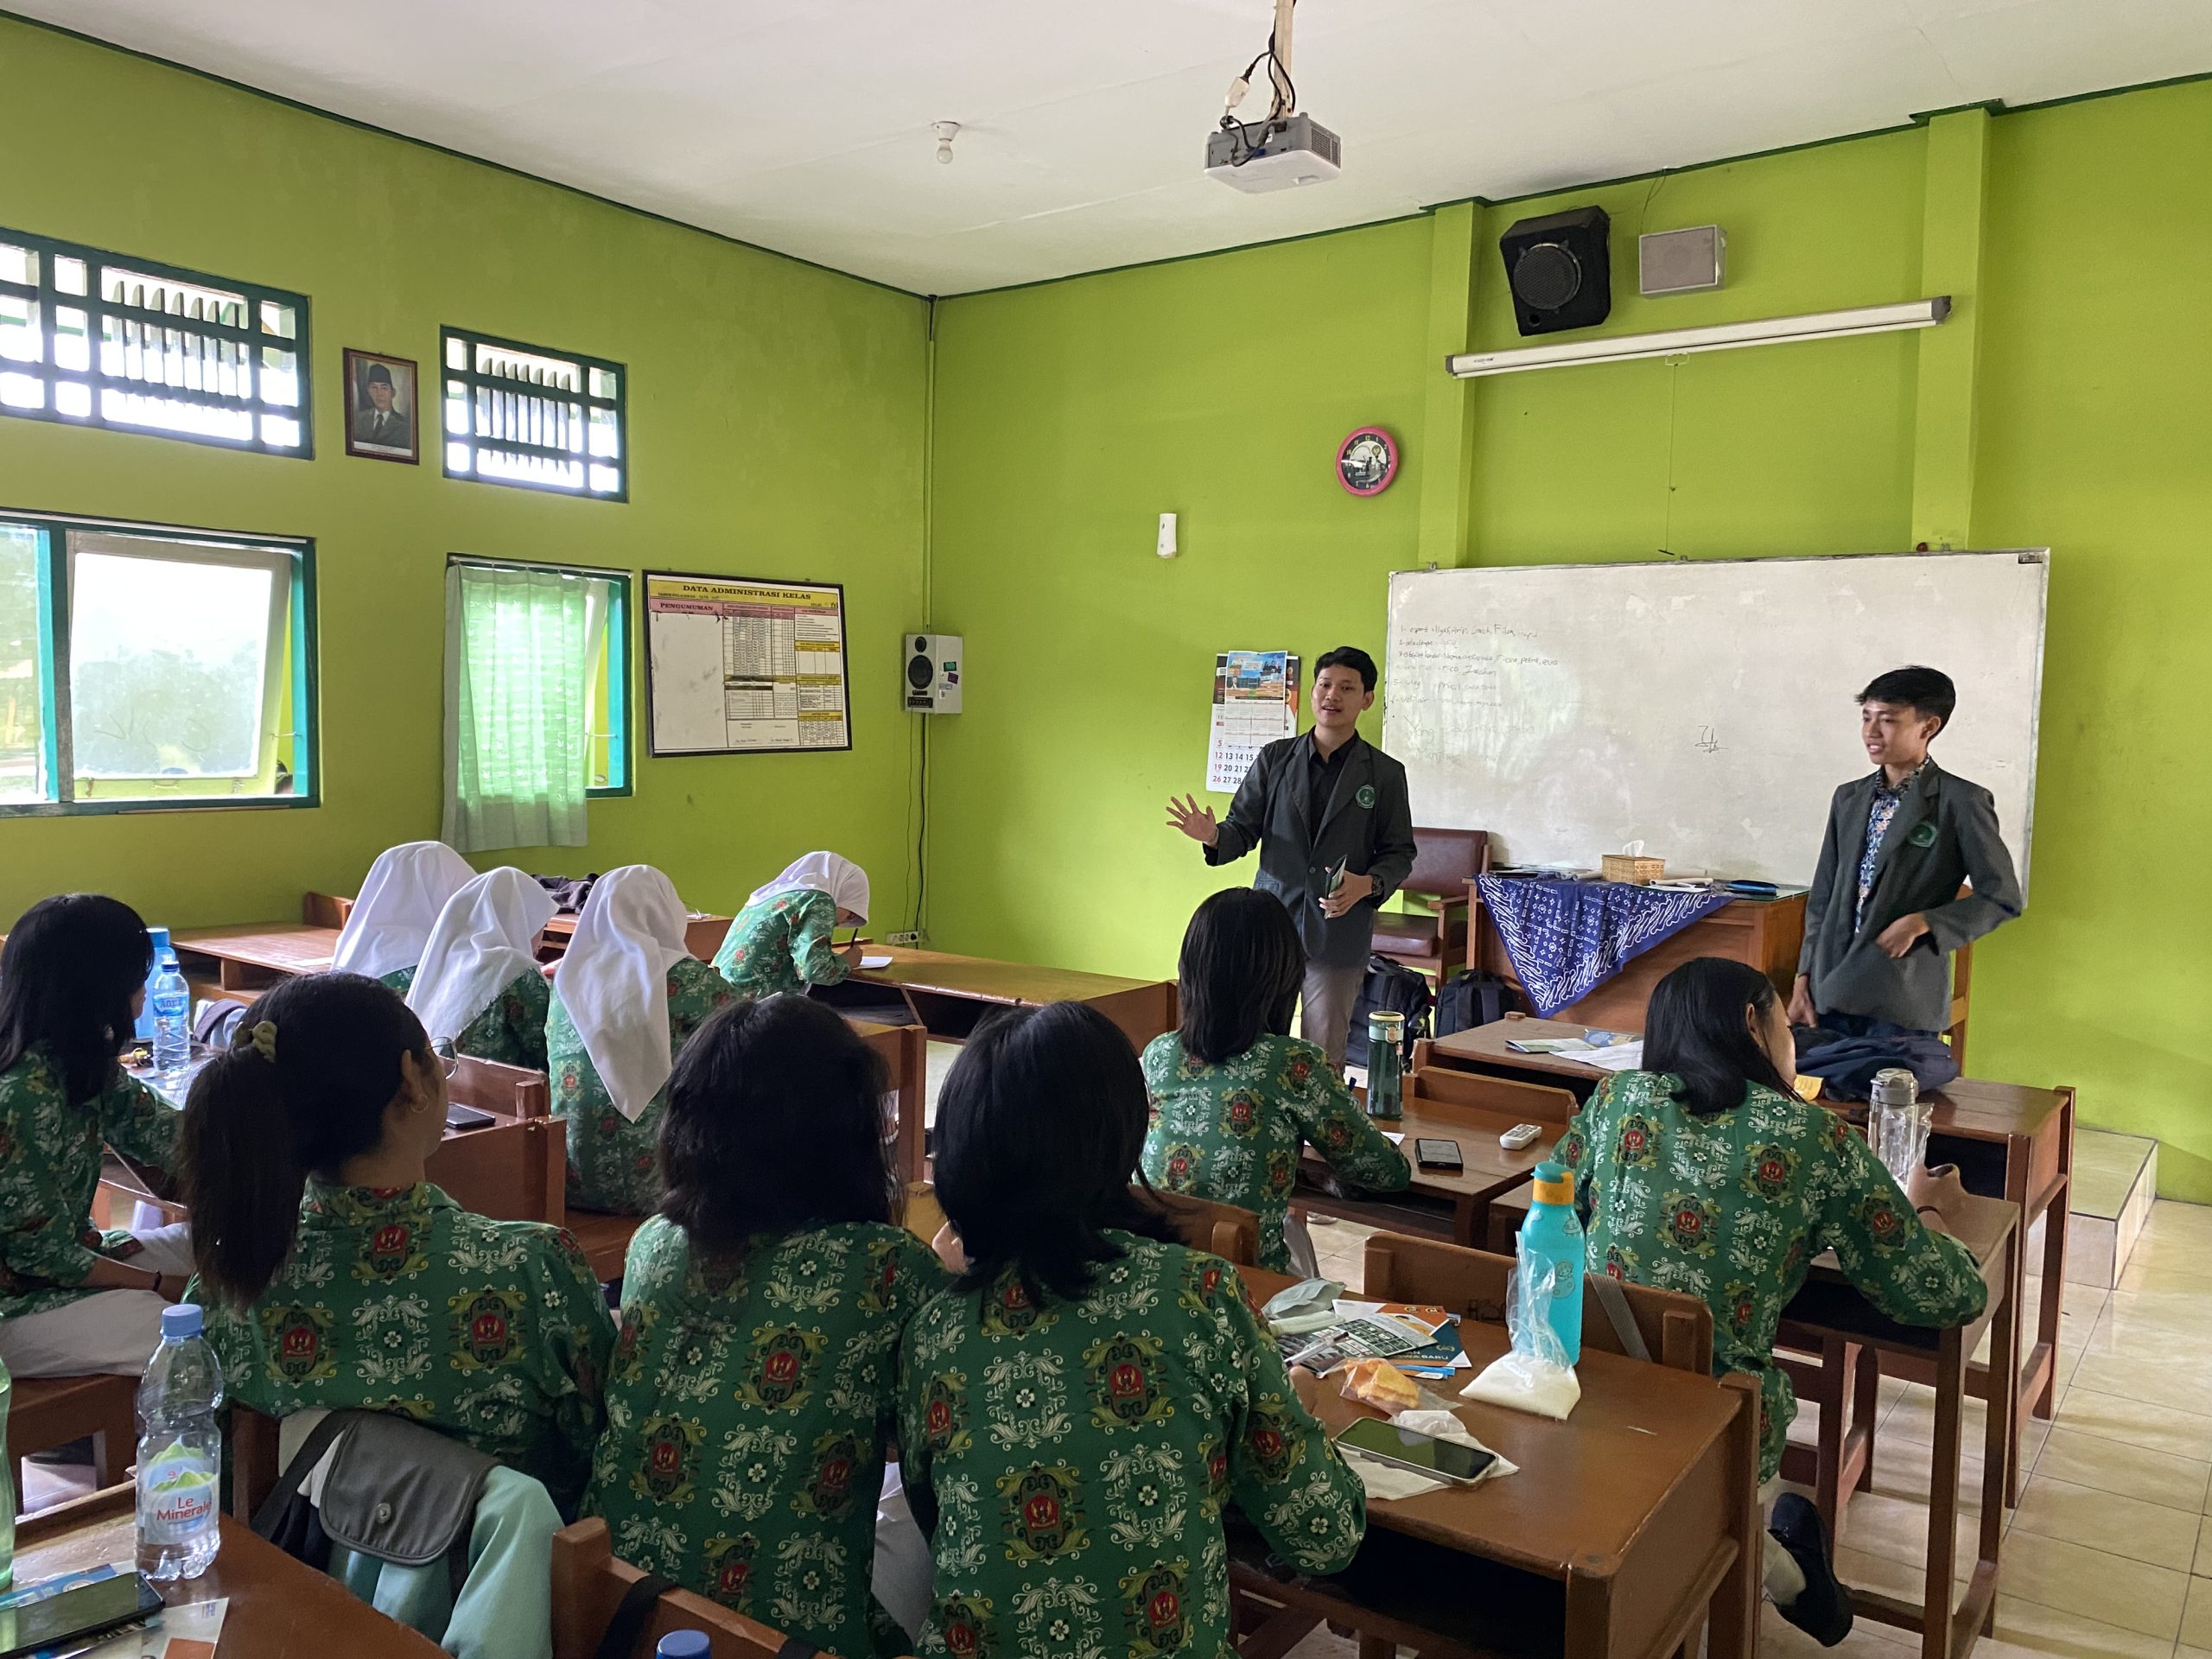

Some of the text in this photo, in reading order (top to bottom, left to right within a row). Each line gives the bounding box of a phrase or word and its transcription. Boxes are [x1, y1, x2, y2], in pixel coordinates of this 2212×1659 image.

[710, 587, 780, 598] ADMINISTRASI
[659, 602, 715, 611] PENGUMUMAN
[177, 1497, 194, 1510] Le
[156, 1501, 213, 1521] Minerale
